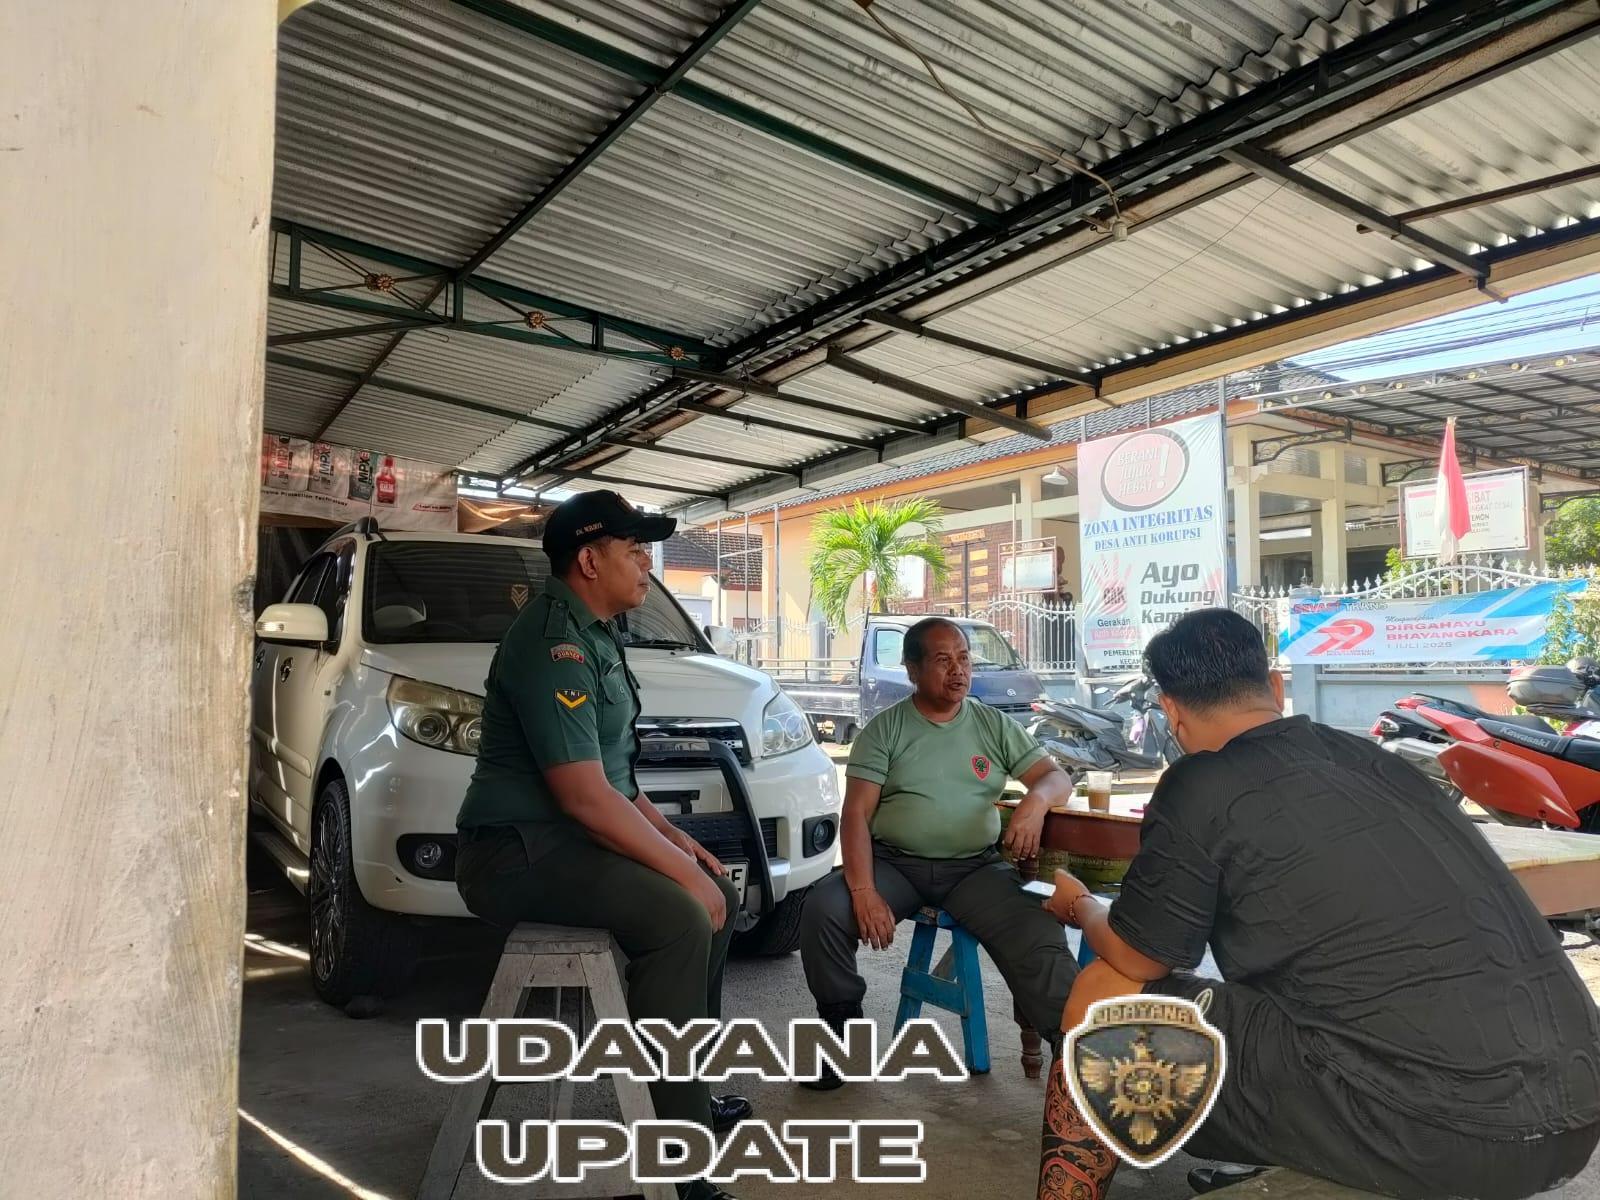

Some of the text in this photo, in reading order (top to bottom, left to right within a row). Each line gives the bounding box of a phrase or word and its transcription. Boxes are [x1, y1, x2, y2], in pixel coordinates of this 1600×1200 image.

[1083, 505, 1213, 537] ZONA INTEGRITAS
[1095, 528, 1201, 551] DESA ANTI KORUPSI
[1140, 562, 1200, 588] Ayo
[1140, 590, 1216, 606] Dukung
[1097, 617, 1131, 627] Gerakan
[1385, 620, 1487, 631] DIRGAHAYU
[1386, 628, 1519, 641] BHAYANGKARA
[1500, 727, 1551, 748] Kawasaki
